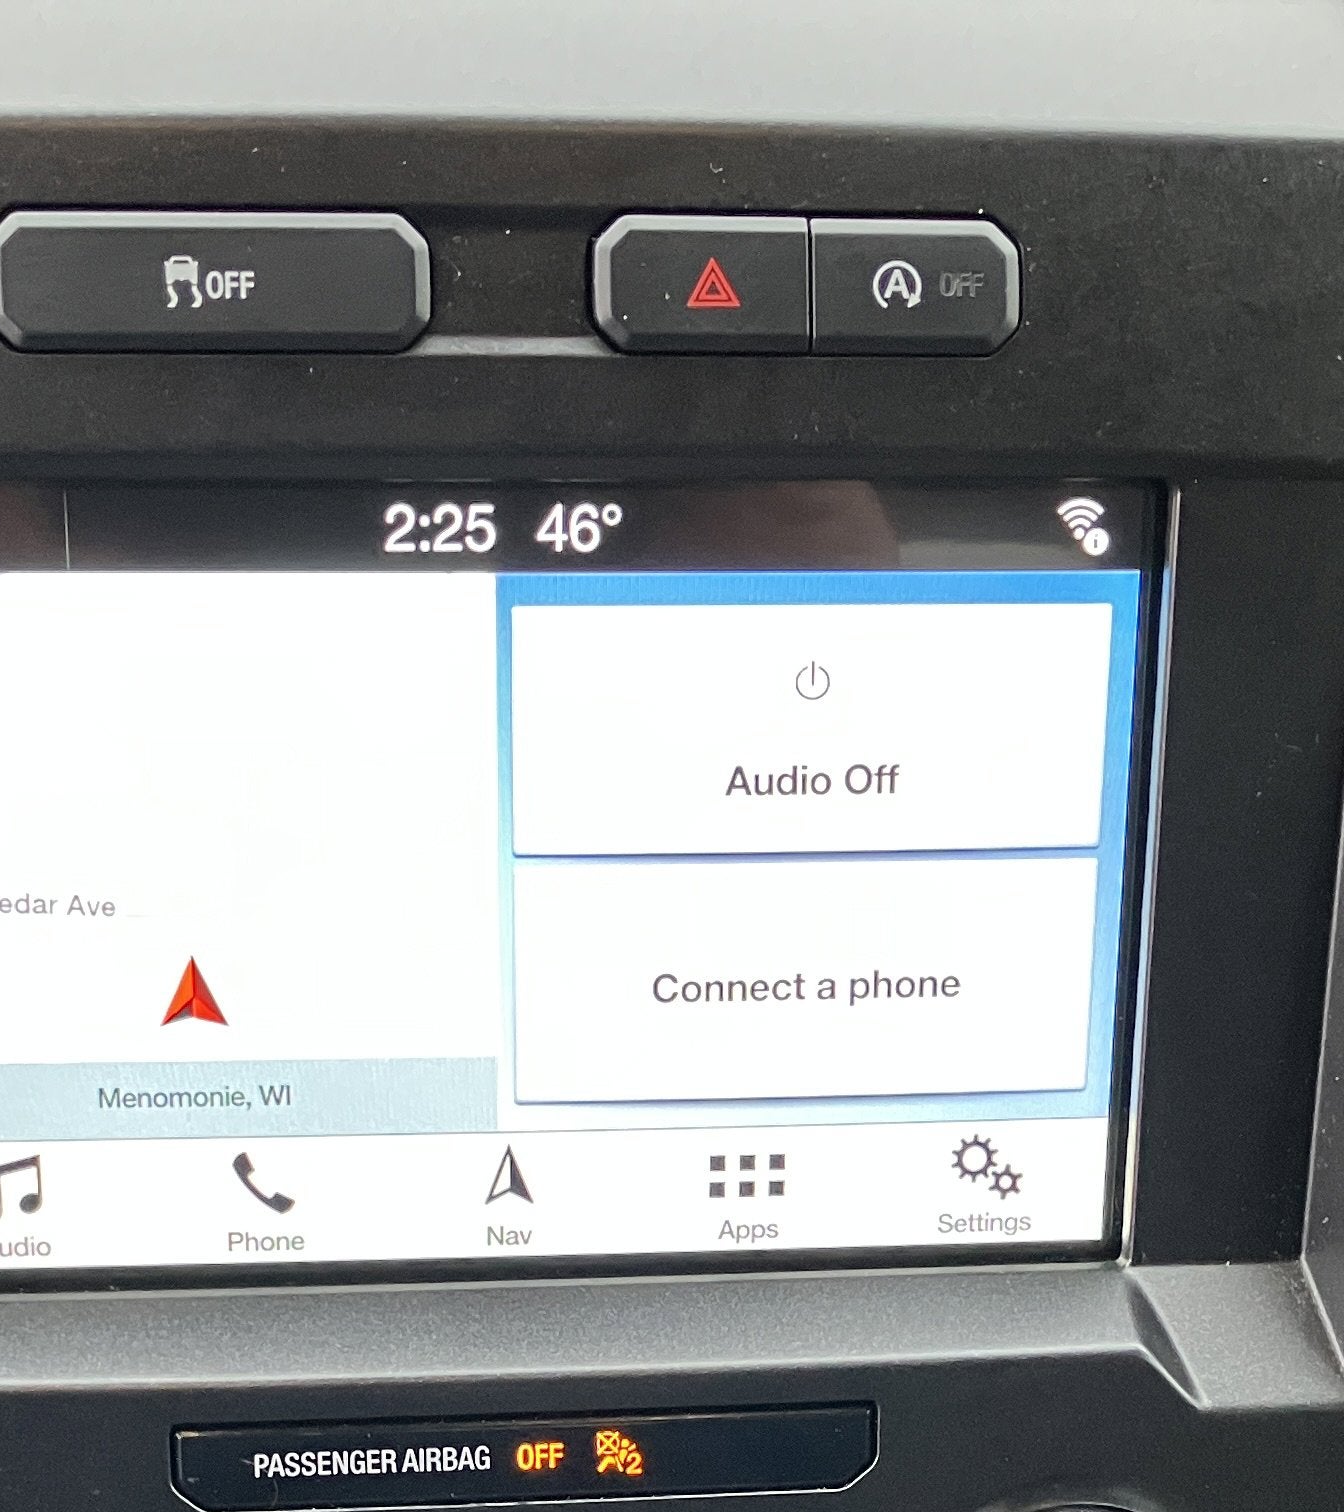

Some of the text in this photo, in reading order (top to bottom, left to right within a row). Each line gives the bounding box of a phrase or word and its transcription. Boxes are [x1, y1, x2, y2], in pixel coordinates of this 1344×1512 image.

[205, 270, 255, 300] OFF
[384, 500, 497, 553] 2:25
[725, 763, 900, 796] Audio Off
[66, 894, 116, 917] Ave
[652, 969, 961, 1007] Connect a phone
[98, 1084, 291, 1111] Menomonie, WI
[487, 1225, 533, 1247] Nav
[717, 1219, 779, 1244] Apps
[937, 1211, 1032, 1236] Settings
[227, 1231, 305, 1252] Phone
[253, 1442, 566, 1479] PASSENGER AIRBAG OFF
